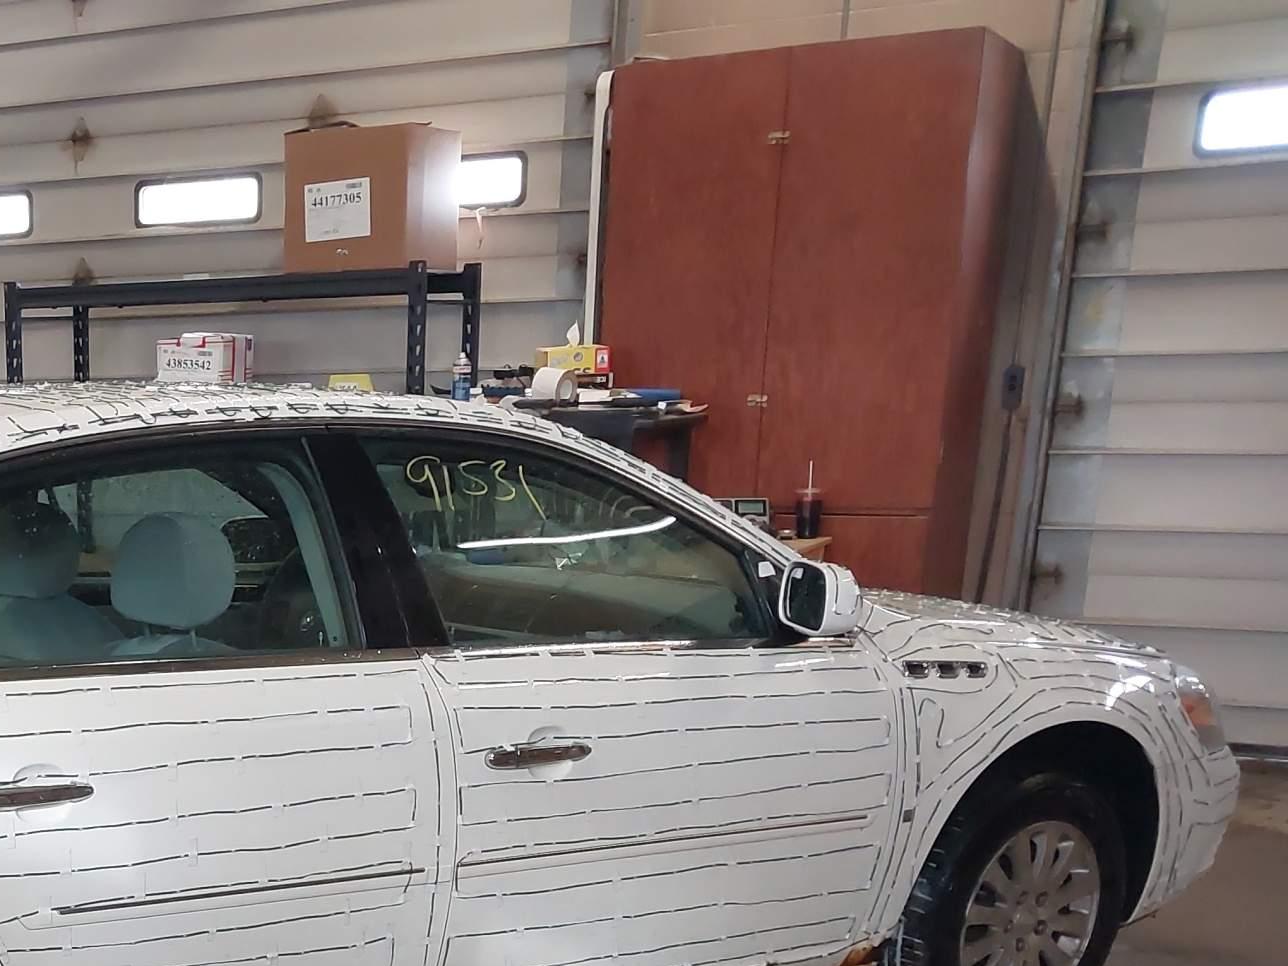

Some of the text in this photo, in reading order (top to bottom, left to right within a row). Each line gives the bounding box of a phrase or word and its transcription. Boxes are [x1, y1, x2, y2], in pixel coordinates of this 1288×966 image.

[311, 191, 362, 207] 44177305
[166, 358, 212, 371] 43853542
[406, 455, 548, 520] 91531
